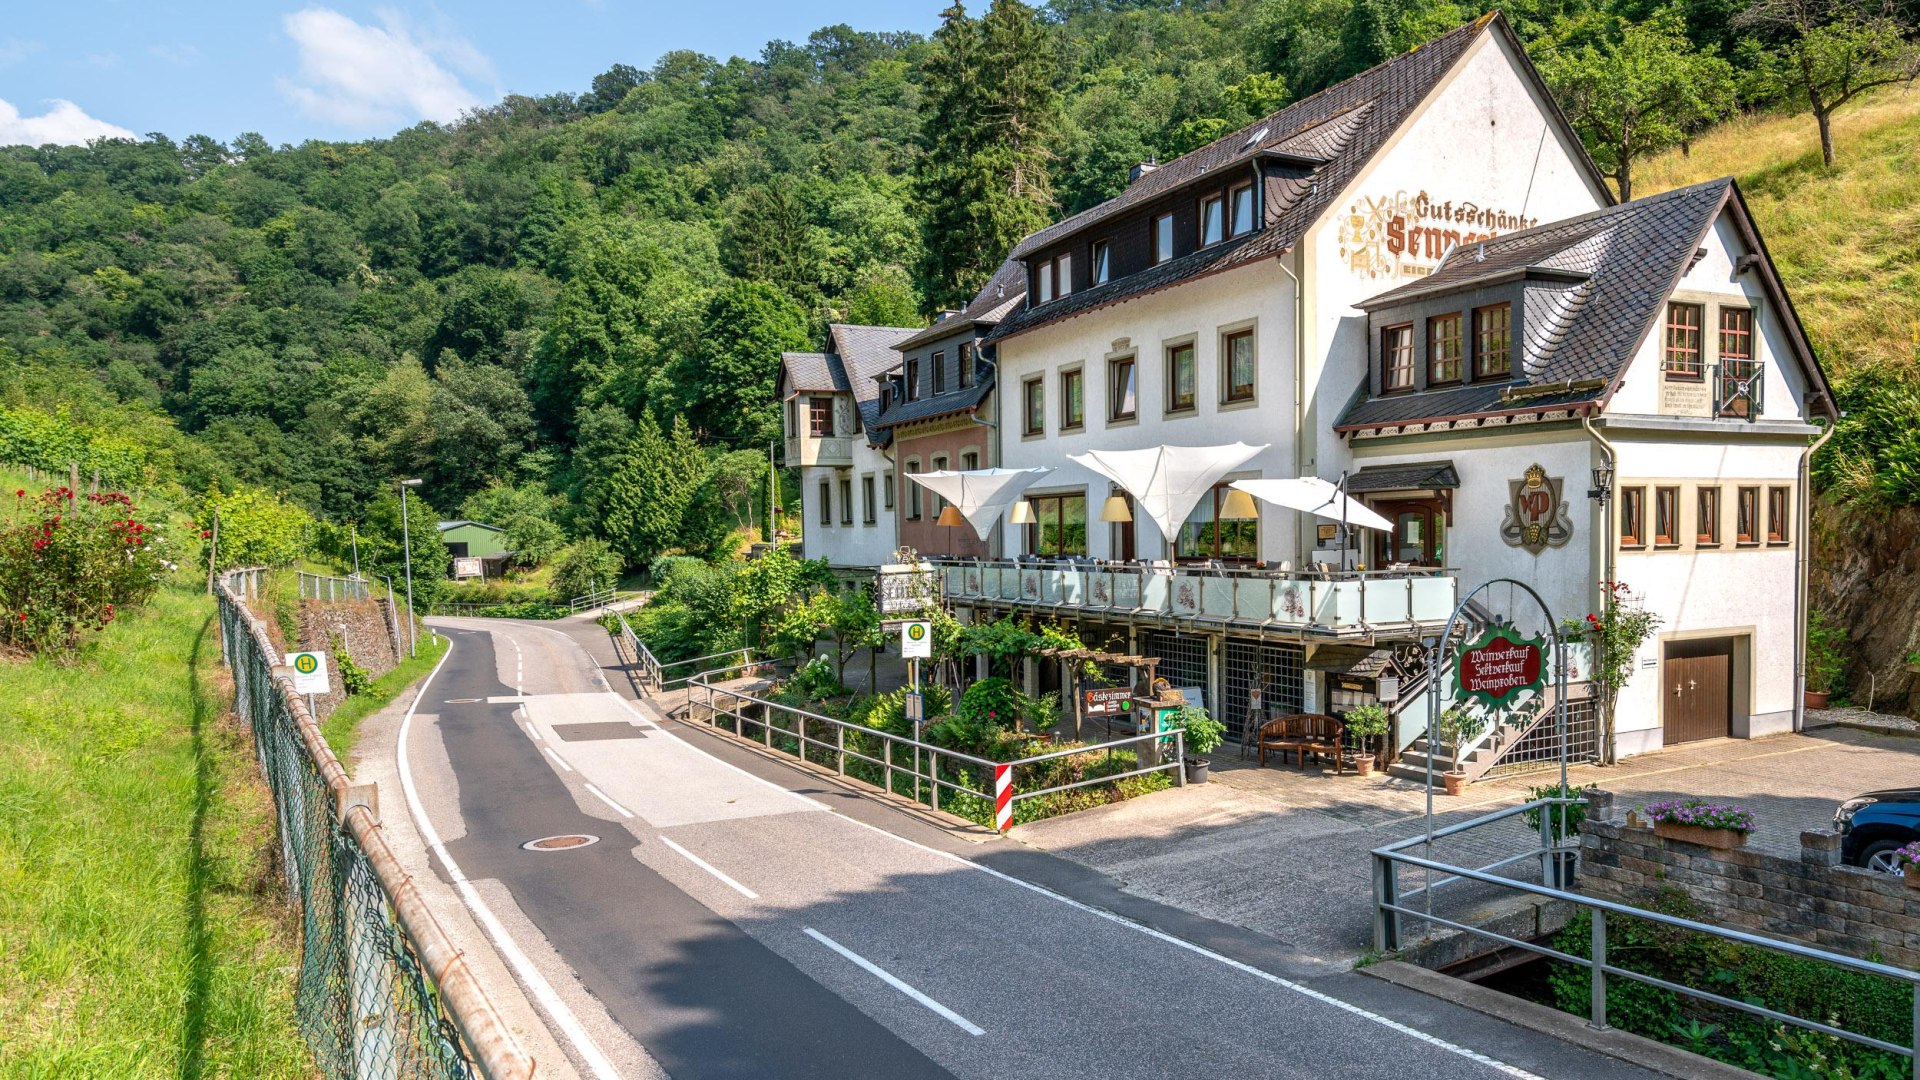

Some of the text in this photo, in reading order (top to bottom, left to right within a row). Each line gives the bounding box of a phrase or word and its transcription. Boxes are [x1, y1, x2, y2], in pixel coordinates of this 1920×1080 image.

[1415, 190, 1538, 232] Gutsschänke
[912, 626, 921, 638] H
[300, 656, 312, 670] H
[1471, 646, 1531, 663] Weinverkauf
[1475, 660, 1525, 677] Sektverkauf
